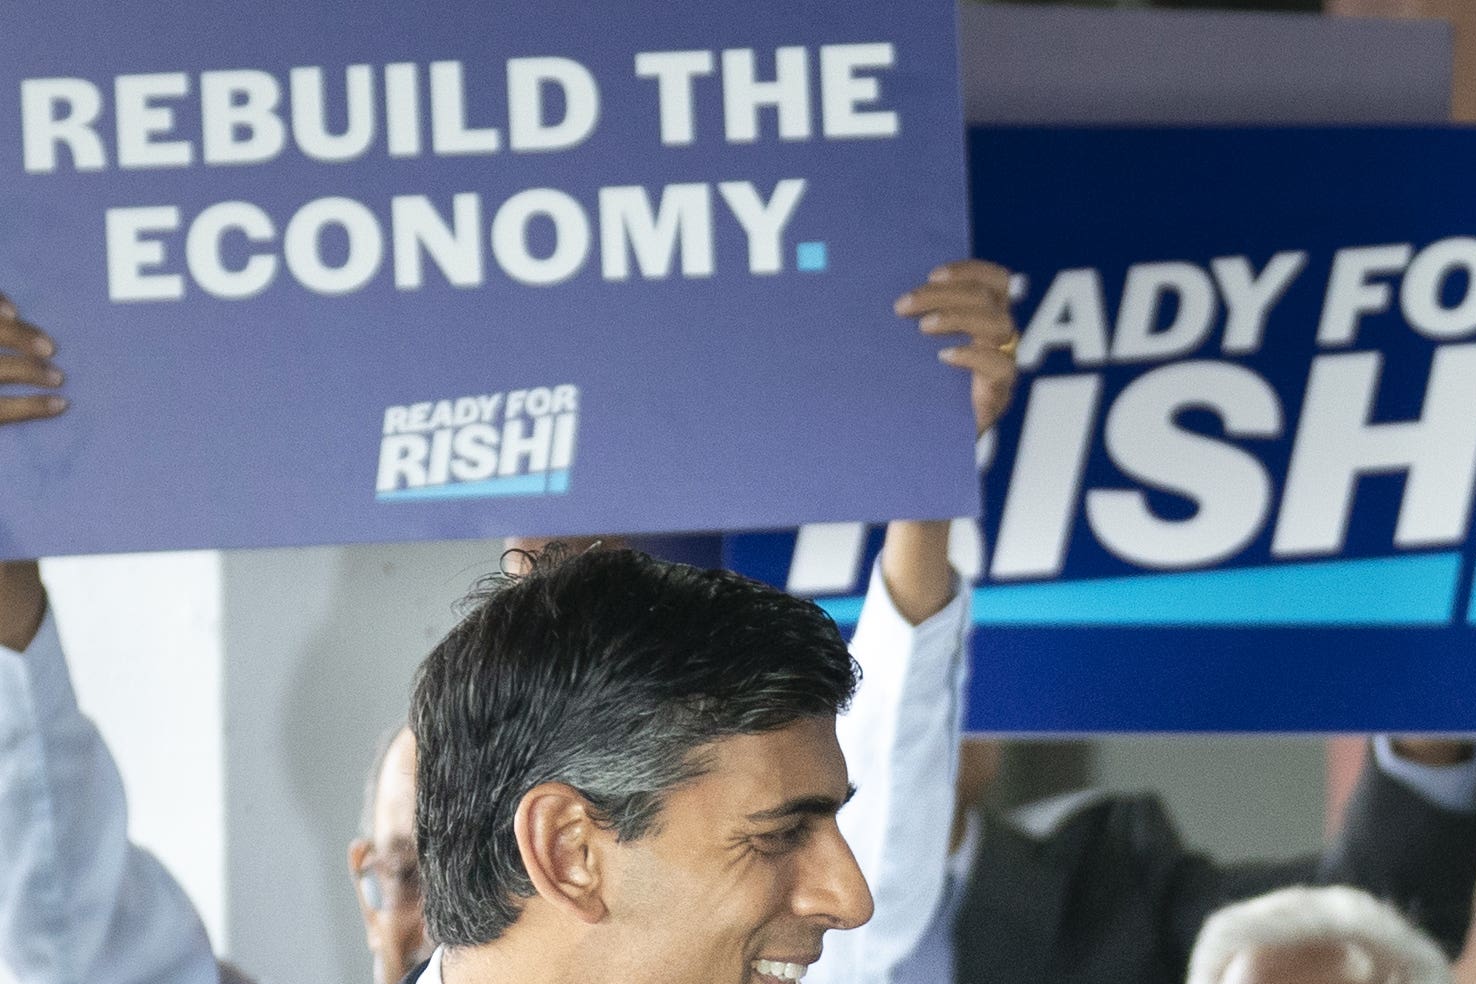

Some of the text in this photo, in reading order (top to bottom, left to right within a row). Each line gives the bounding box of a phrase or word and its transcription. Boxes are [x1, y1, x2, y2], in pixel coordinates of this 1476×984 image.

[20, 43, 899, 173] REBUILD THE
[105, 179, 827, 301] ECONOMY.
[374, 412, 577, 491] RISHI
[382, 383, 578, 436] READY FOR
